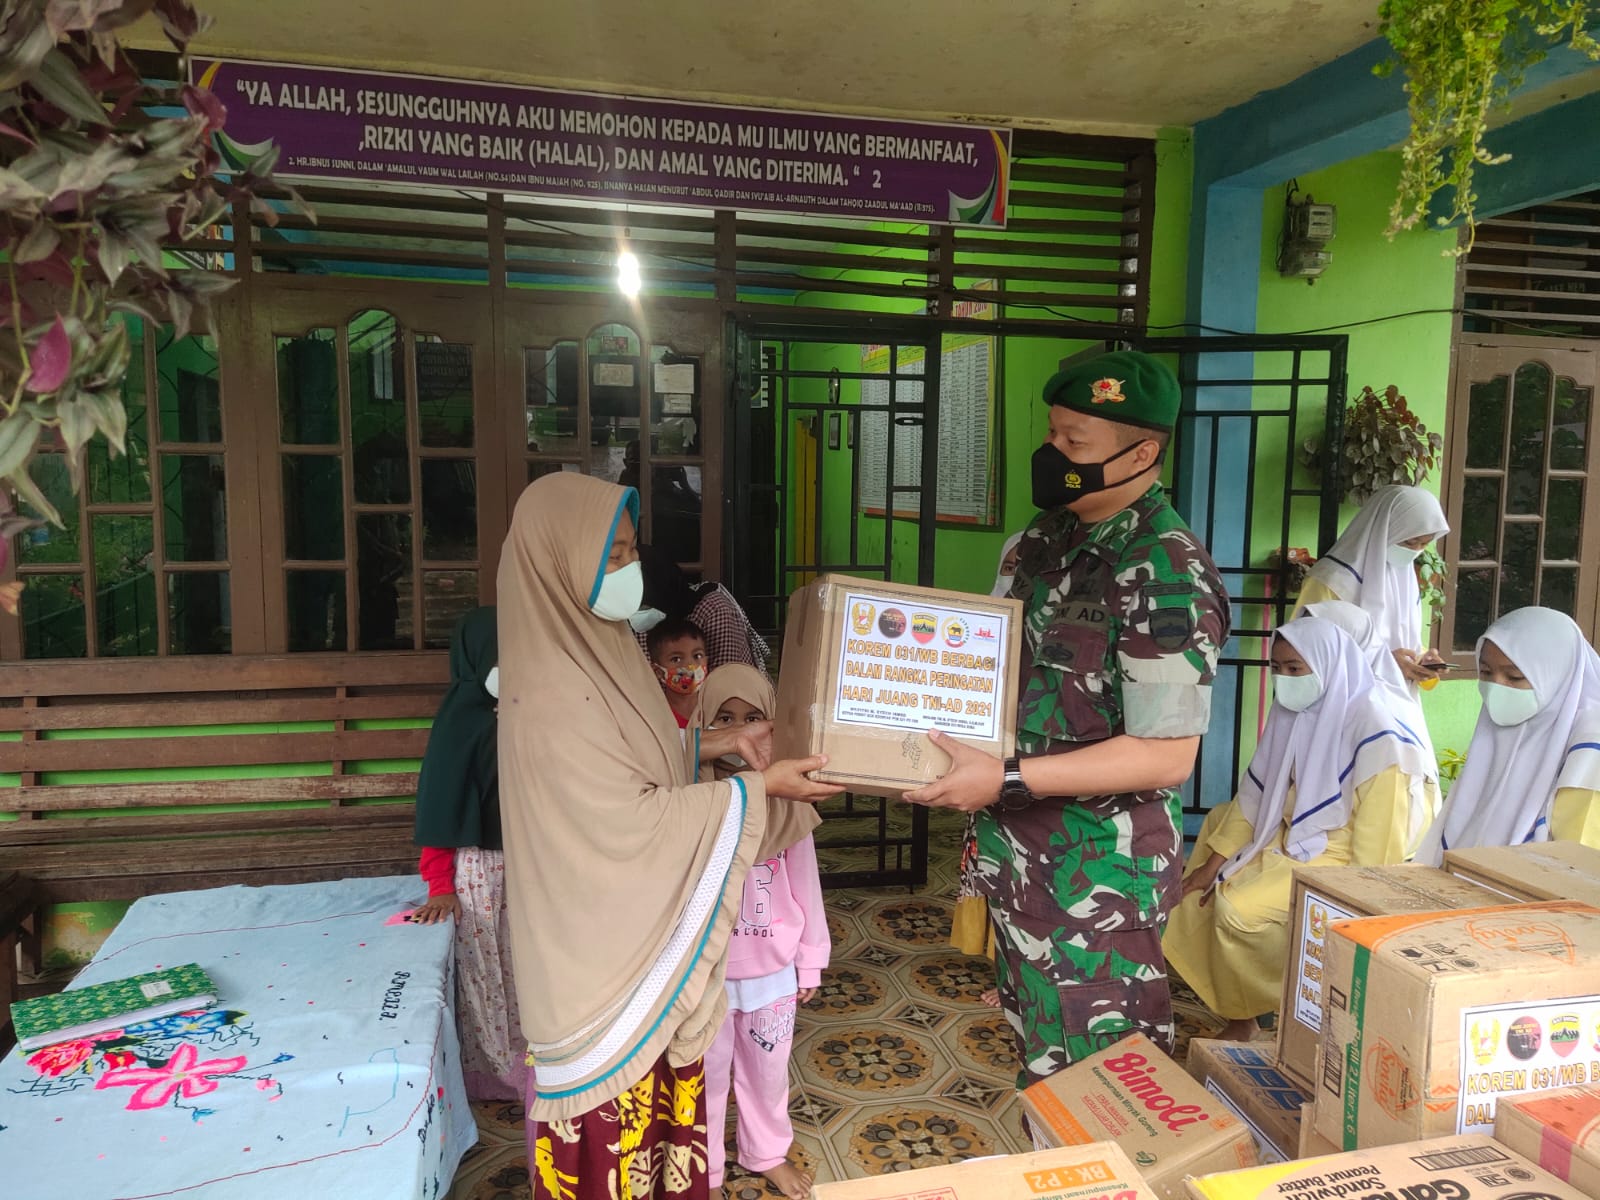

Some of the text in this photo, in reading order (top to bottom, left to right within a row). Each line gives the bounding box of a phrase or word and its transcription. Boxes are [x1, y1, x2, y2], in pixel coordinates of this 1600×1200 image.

[279, 84, 351, 115] ALLAH,
[357, 90, 511, 126] SESUNGGUHNYA
[516, 105, 554, 130] AKU
[560, 109, 657, 139] MEMOHON
[662, 118, 732, 145] KEPADA
[738, 125, 763, 148] MU
[768, 127, 808, 151] ILMU
[813, 131, 860, 155] YANG
[865, 135, 978, 167] BERMANFAAT,
[419, 130, 473, 157] YANG
[480, 135, 523, 161] BAIK
[529, 140, 610, 172] (HALAL),
[615, 147, 654, 172] DAN
[658, 151, 708, 175] AMAL
[713, 155, 762, 179] YANG
[767, 159, 848, 185] DITERIMA.
[872, 170, 882, 188] 2
[358, 161, 383, 171] DALAM
[418, 167, 439, 176] YAUM
[440, 168, 456, 178] WAL
[458, 170, 483, 179] LAILAH
[528, 175, 544, 184] IBNU
[634, 184, 656, 192] HASAN
[658, 185, 688, 195] MENURUT
[714, 189, 734, 198] QADIR
[736, 191, 750, 199] DAN
[817, 197, 838, 205] DALAM
[865, 200, 888, 209] ZAADUL
[1077, 607, 1104, 623] AD
[848, 639, 996, 672] KOREM 031/WB BERBAGI
[846, 661, 994, 694] DALAM RANGKA PERINGATAN
[842, 685, 872, 702] HARI
[876, 690, 918, 708] JUANG
[922, 695, 962, 713] TNI-AD
[966, 700, 992, 717] 2021
[1103, 1052, 1209, 1132] Bimoli
[1347, 1078, 1358, 1110] Liter
[1467, 1069, 1526, 1095] KOREM
[1532, 1062, 1586, 1089] 031/WB
[1346, 1124, 1356, 1136] 6
[1465, 1103, 1495, 1126] DAL
[1276, 1165, 1381, 1194] Peanut Butter
